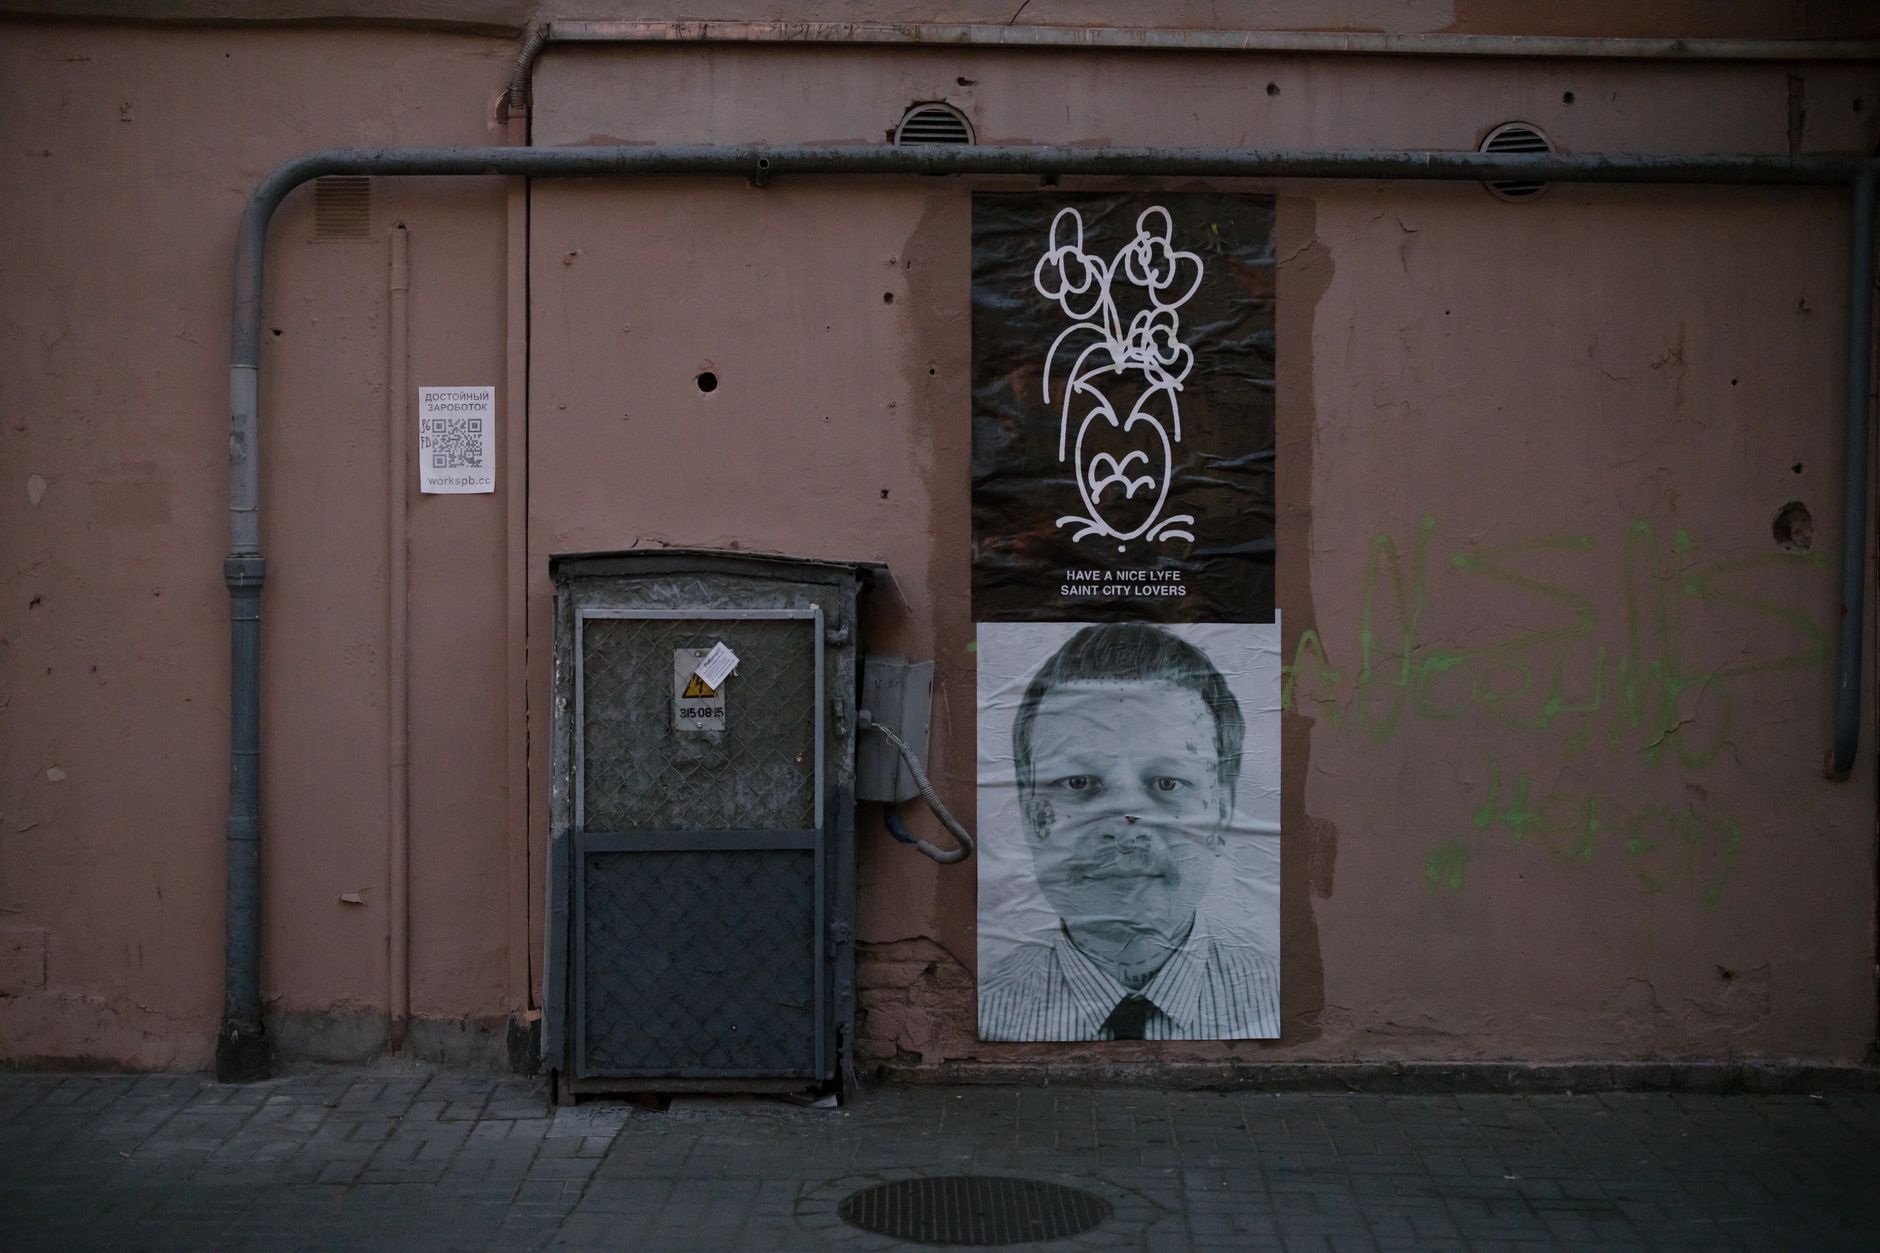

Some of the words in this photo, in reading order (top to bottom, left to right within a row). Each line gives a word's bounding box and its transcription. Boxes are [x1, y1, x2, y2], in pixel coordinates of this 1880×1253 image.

[425, 391, 489, 402] ДОСТОЙНЫЙ
[427, 403, 488, 412] ЗАРОБОТОК
[428, 475, 491, 487] workspb.cc
[1066, 570, 1100, 581] HAVE
[1104, 570, 1113, 581] A
[1116, 570, 1146, 581] NICE
[1150, 570, 1181, 581] LYFE
[1060, 585, 1099, 596] SAINT
[1102, 585, 1131, 596] CITY
[1134, 585, 1187, 596] LOVERS
